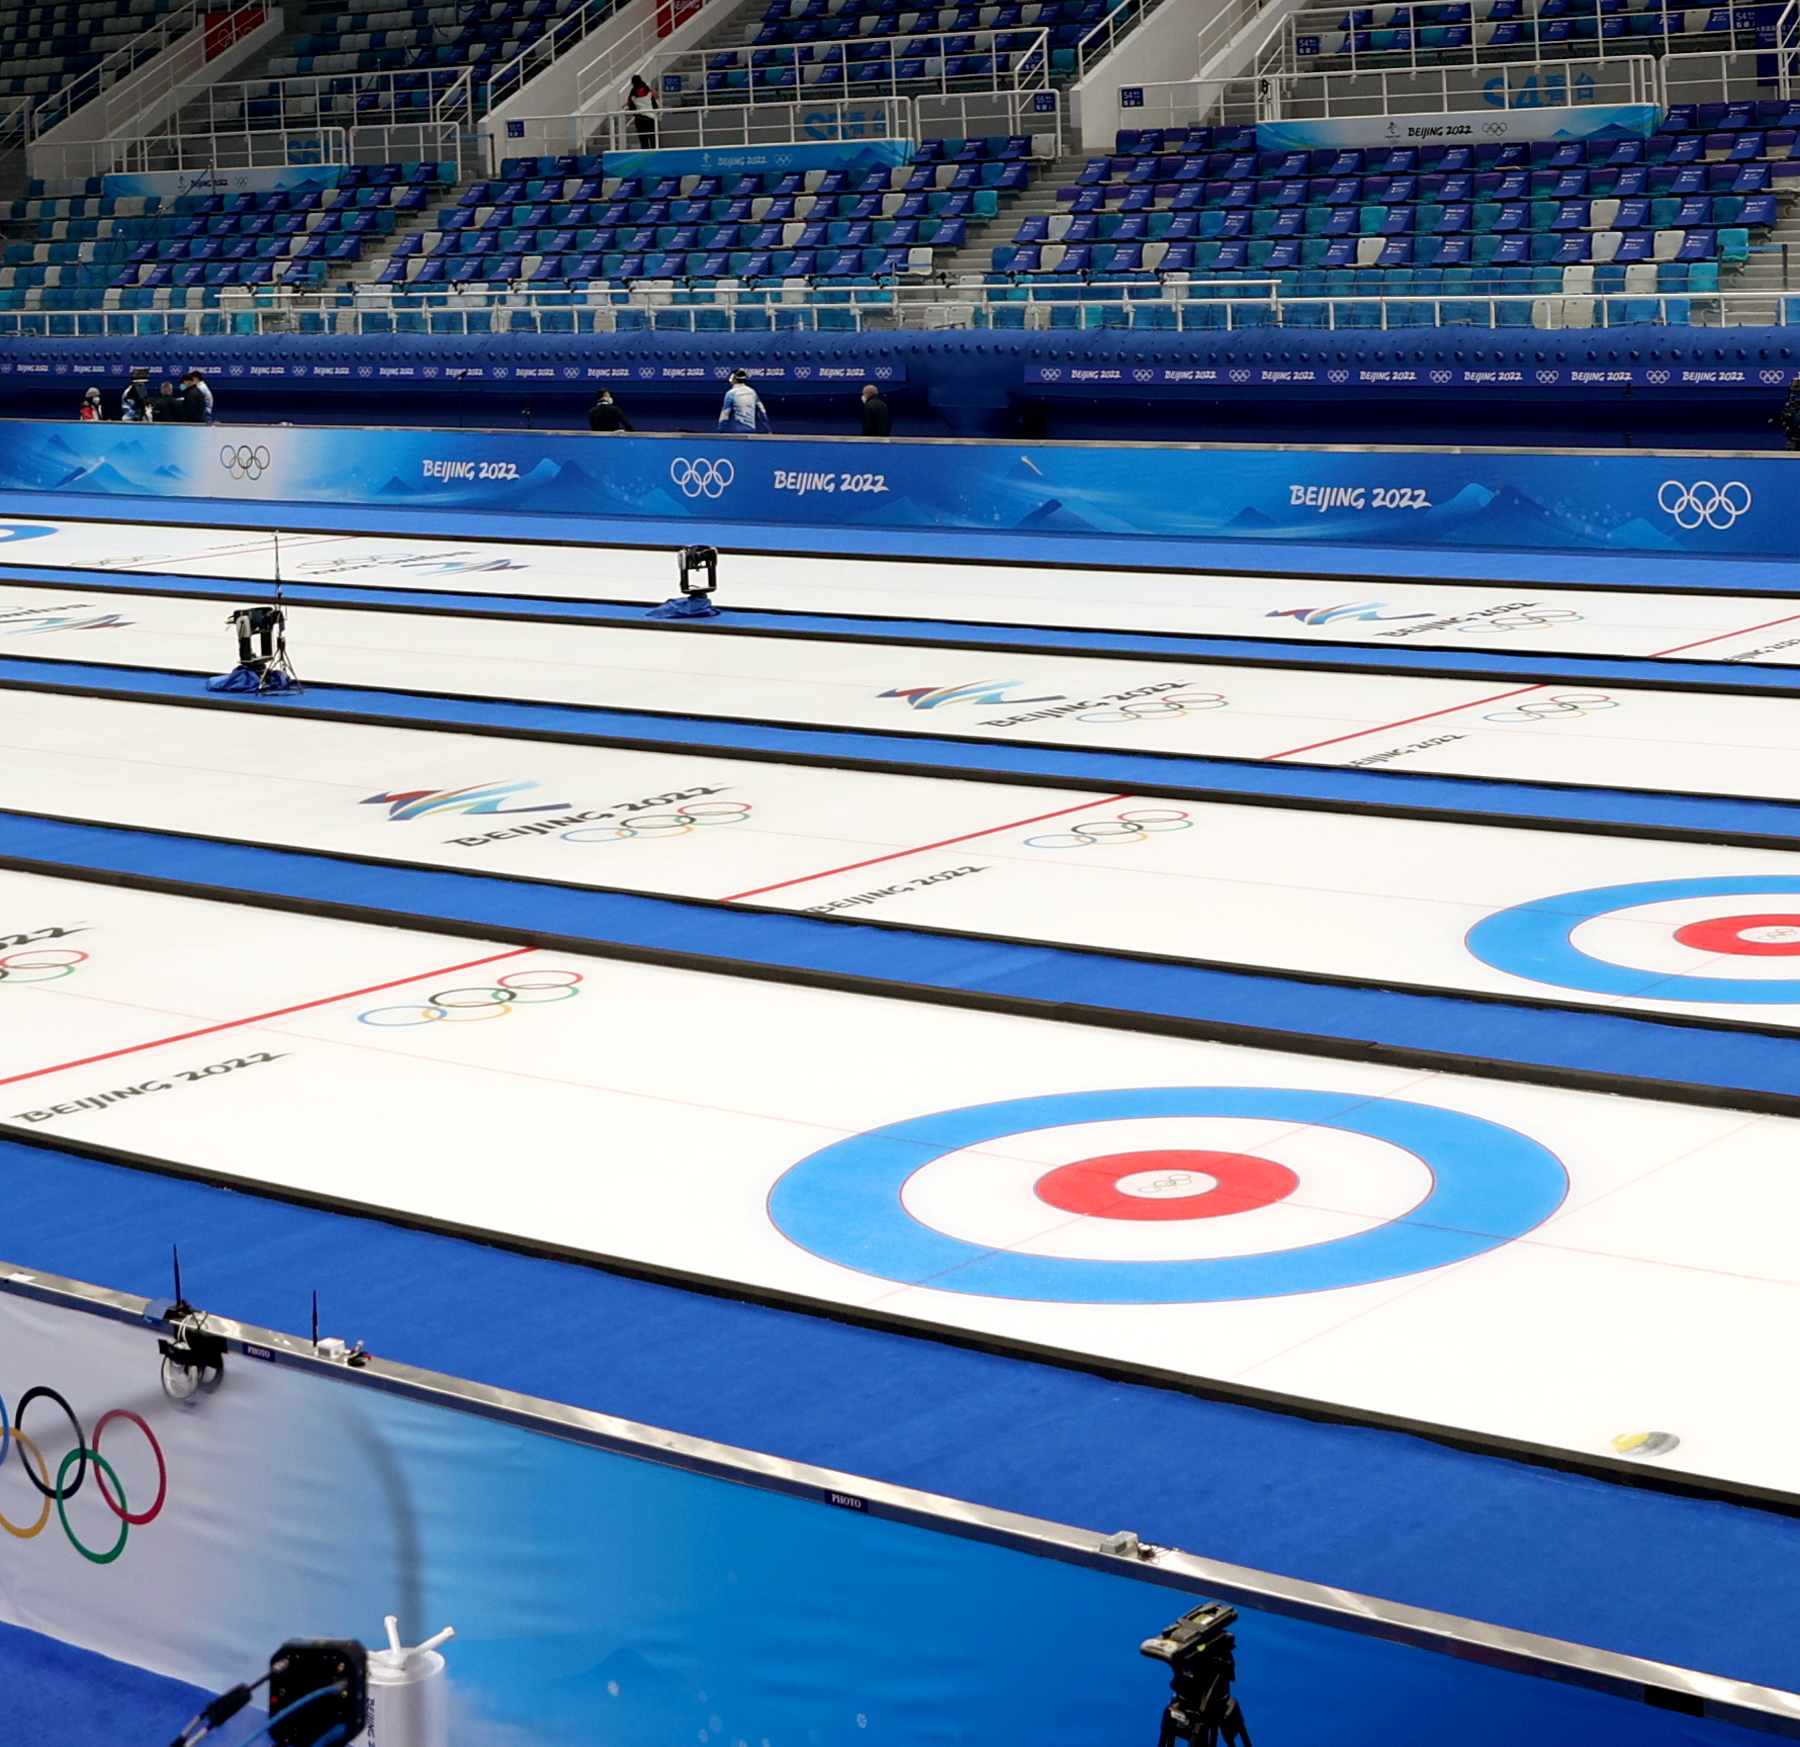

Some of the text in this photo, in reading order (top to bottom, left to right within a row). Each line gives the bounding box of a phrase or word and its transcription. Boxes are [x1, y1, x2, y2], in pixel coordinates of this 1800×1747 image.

[1736, 12, 1747, 20] S4
[1299, 39, 1308, 48] S4
[1123, 91, 1133, 99] S4
[1408, 125, 1473, 139] BEIJING 2022
[1464, 372, 1523, 383] BEIJING 2022
[1572, 372, 1632, 383] BEIJING 2022
[1683, 372, 1745, 383] BEIJING 2022
[423, 460, 520, 482] BEIJING 2022
[774, 471, 889, 495] BEIJING 2022
[1290, 485, 1432, 512] BEIJING 2022
[1378, 601, 1540, 637] BEIJING 2022
[976, 682, 1198, 727] BEIJING 2022
[1408, 734, 1470, 751] 2022
[442, 786, 735, 848] BEIJING 2022
[800, 866, 992, 915] BEIJING 2022
[12, 1052, 295, 1126] BEIJING 2022
[247, 1345, 271, 1359] PHOTO
[831, 1492, 862, 1509] PHOTO
